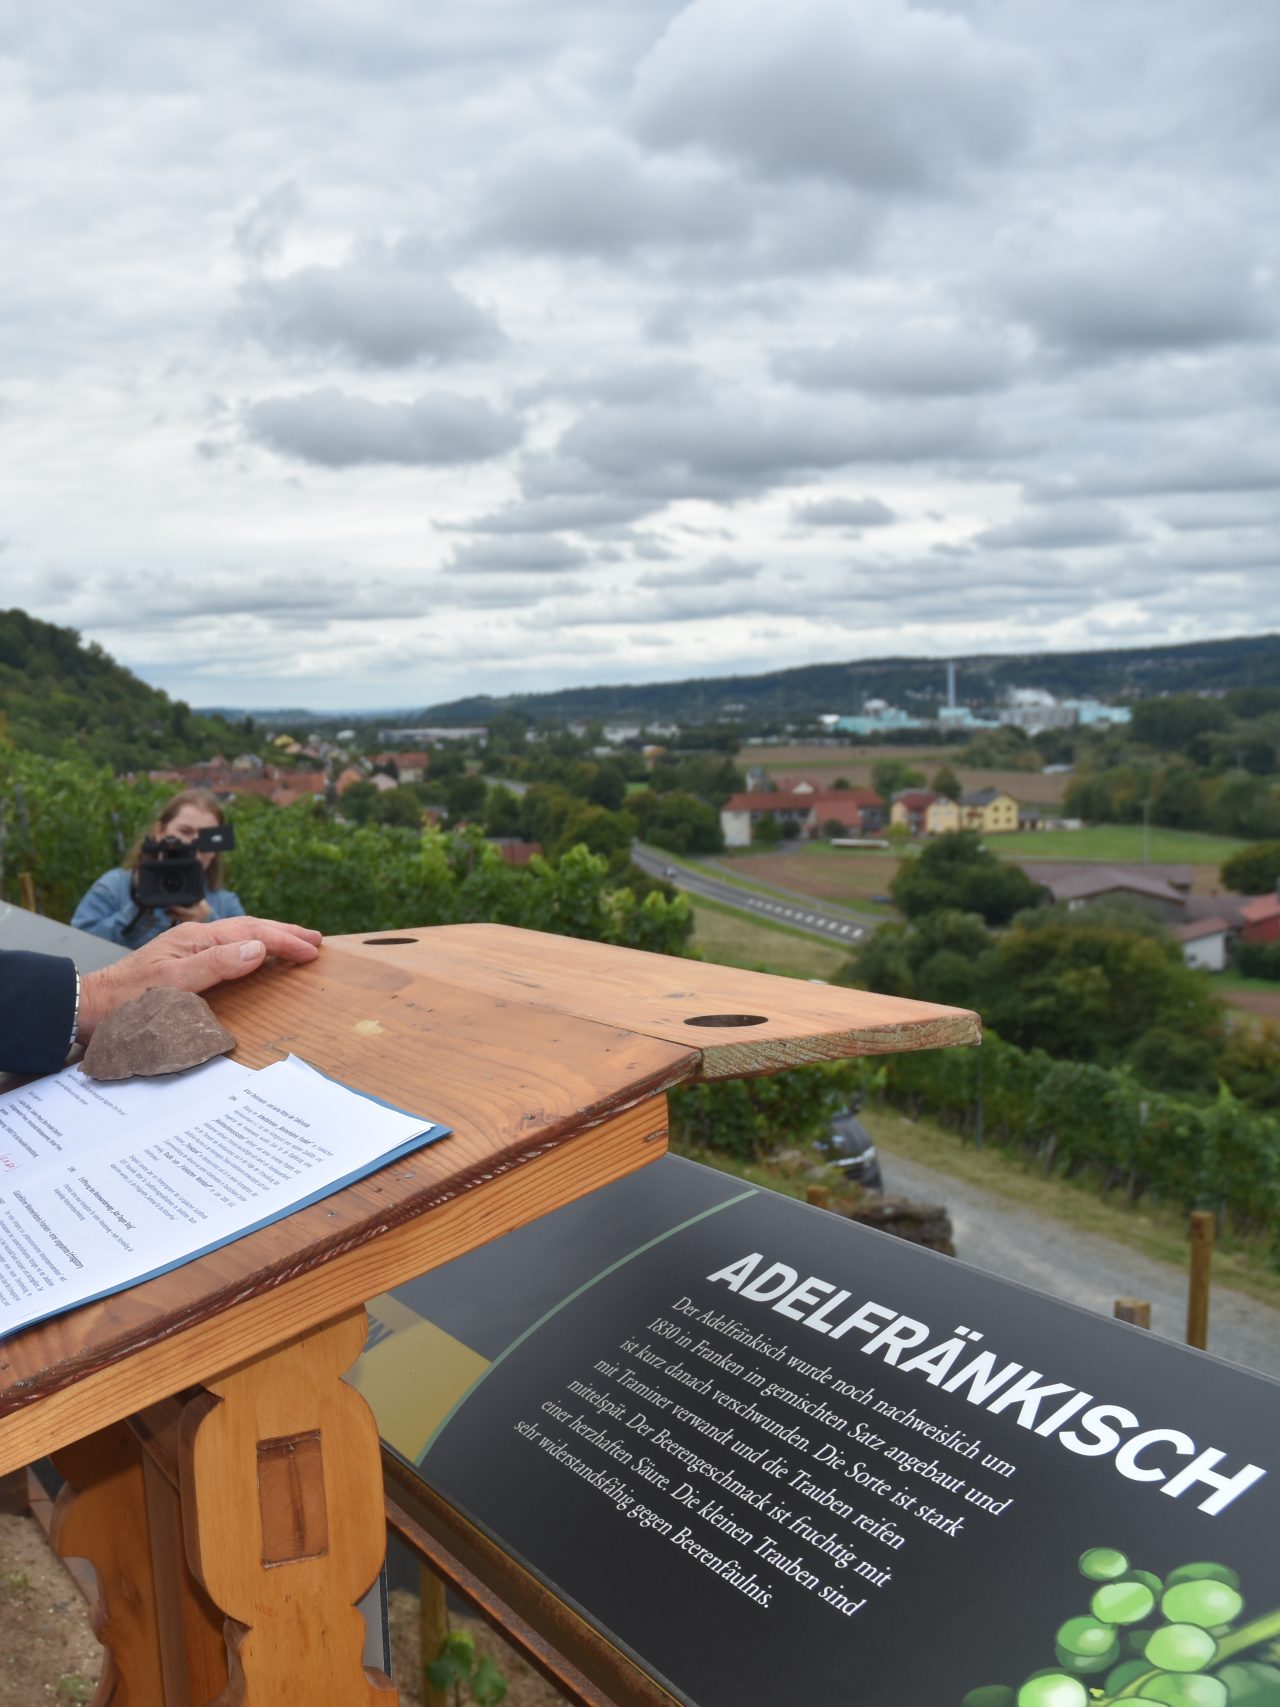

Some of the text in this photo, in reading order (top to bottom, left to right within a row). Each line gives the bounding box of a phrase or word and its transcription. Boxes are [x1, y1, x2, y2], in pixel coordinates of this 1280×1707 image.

[566, 1380, 892, 1588] mittelspät. Der Beerengeschmack ist fruchtig mit
[593, 1360, 906, 1551] mit Traminer verwandt und die Trauben reifen
[619, 1335, 966, 1538] ist kurz danach verschwunden. Die Sorte ist stark
[646, 1317, 1015, 1516] 1830 in Franken im gemischten Satz angebaut und
[671, 1296, 1017, 1479] Der Adelfränkisch wurde noch nachweislich um
[707, 1253, 1266, 1516] ADELFRÄNKISCH
[513, 1420, 773, 1609] sehr widerstandsfähig gegen Beerenfäulnis.
[541, 1400, 868, 1617] einer herzhaften Säure. Die kleinen Trauben sind
